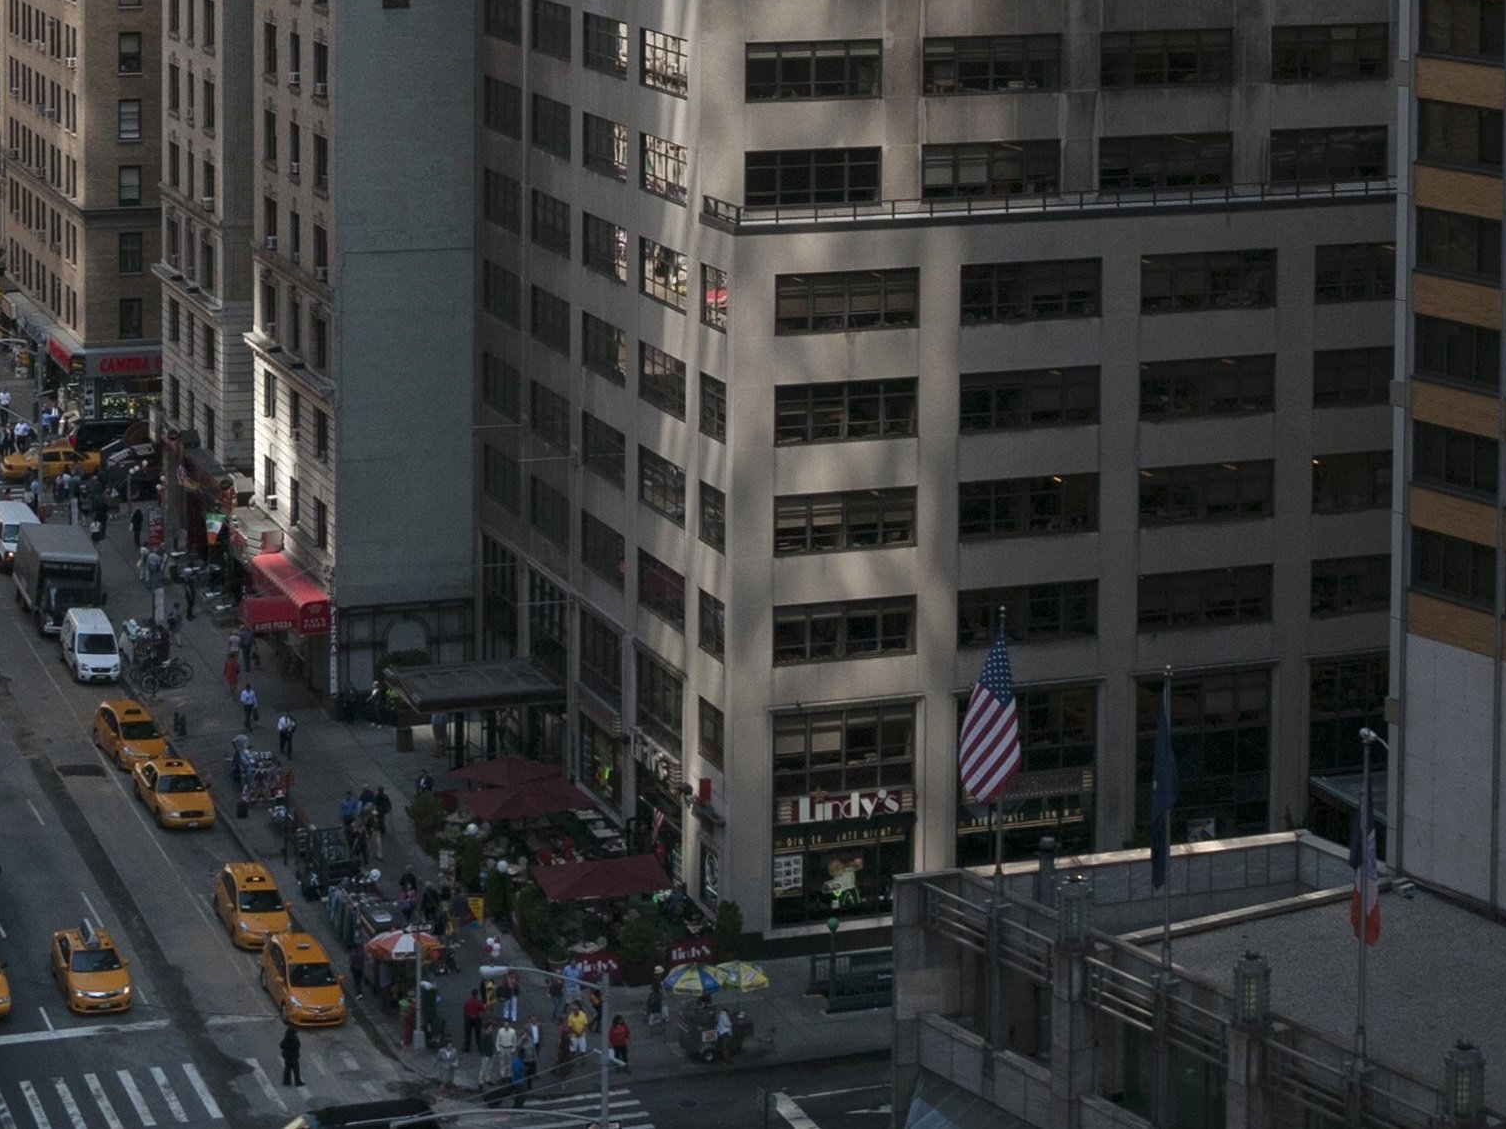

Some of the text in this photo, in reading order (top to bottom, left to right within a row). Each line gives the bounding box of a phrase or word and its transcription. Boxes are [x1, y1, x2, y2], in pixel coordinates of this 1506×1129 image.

[100, 357, 150, 373] CAMERA
[798, 788, 900, 823] Lindy's
[787, 834, 822, 847] DINER
